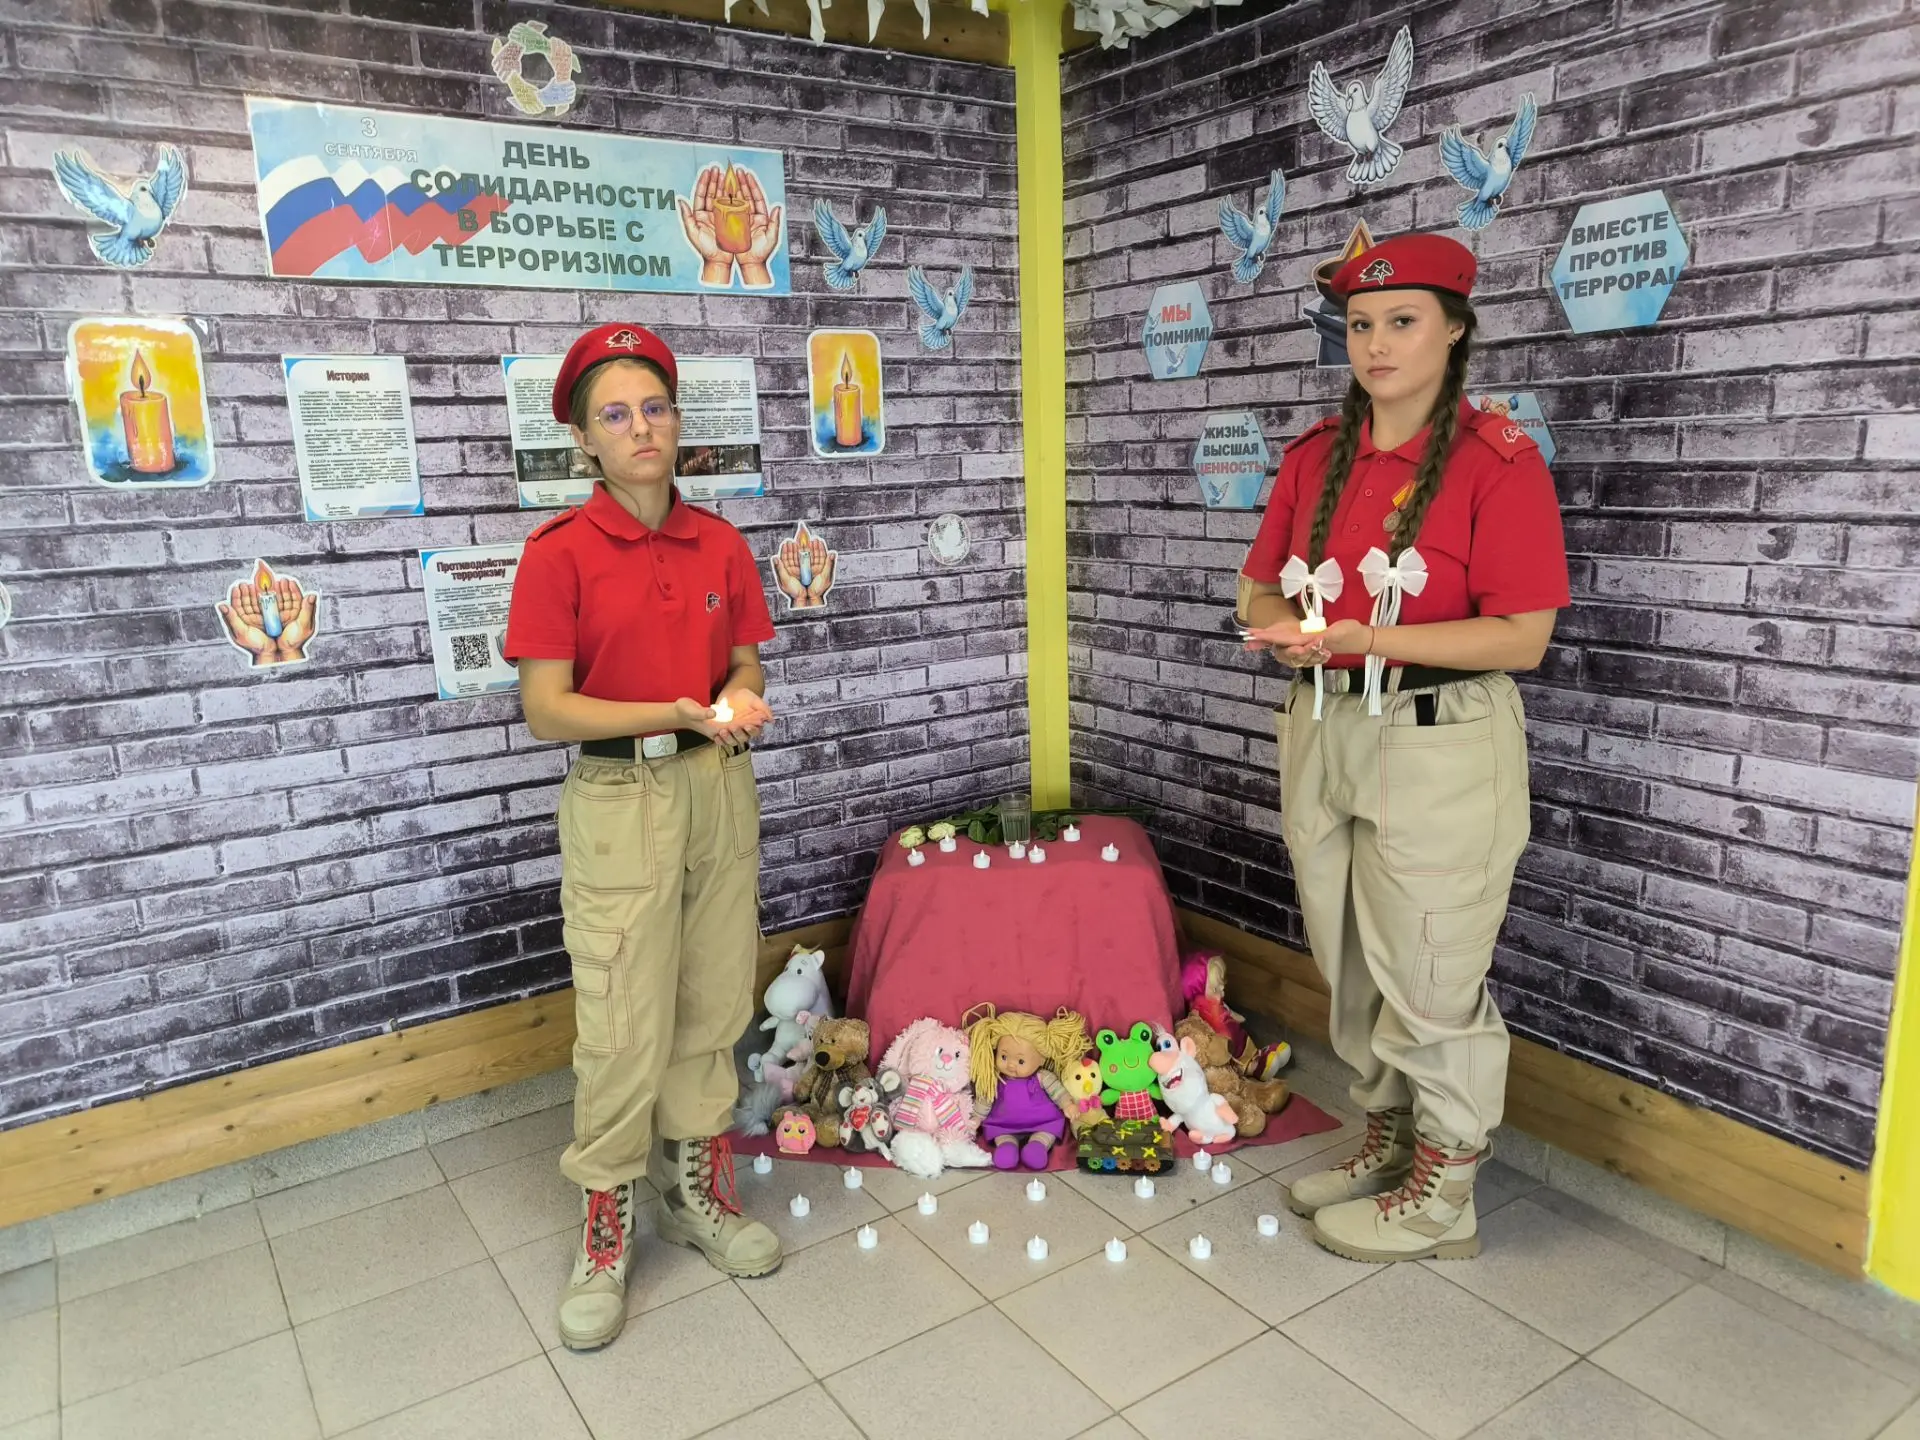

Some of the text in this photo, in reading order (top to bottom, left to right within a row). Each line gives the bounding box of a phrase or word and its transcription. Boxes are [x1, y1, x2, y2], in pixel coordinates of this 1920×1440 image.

[361, 117, 378, 138] 3
[324, 142, 418, 163] СЕНТЯБРЯ
[503, 141, 590, 169] ДЕНЬ
[410, 168, 676, 212] СОЛИДАРНОСТИ
[458, 210, 644, 242] В БОРЬБЕ С
[1571, 211, 1669, 246] ВМЕСТЕ
[433, 244, 671, 277] ТЕРРОРИЗМОМ
[1569, 240, 1667, 273] ПРОТИВ
[1560, 265, 1677, 300] ТЕРРОРА!
[1161, 303, 1192, 323] МЫ
[1144, 327, 1210, 348] ПОМНИМ!
[326, 370, 370, 383] История
[1204, 425, 1249, 440] ЖИЗНЬ
[1203, 443, 1259, 457] ВЫСШАЯ
[436, 557, 518, 573] Противодействие
[451, 568, 506, 582] терроризму
